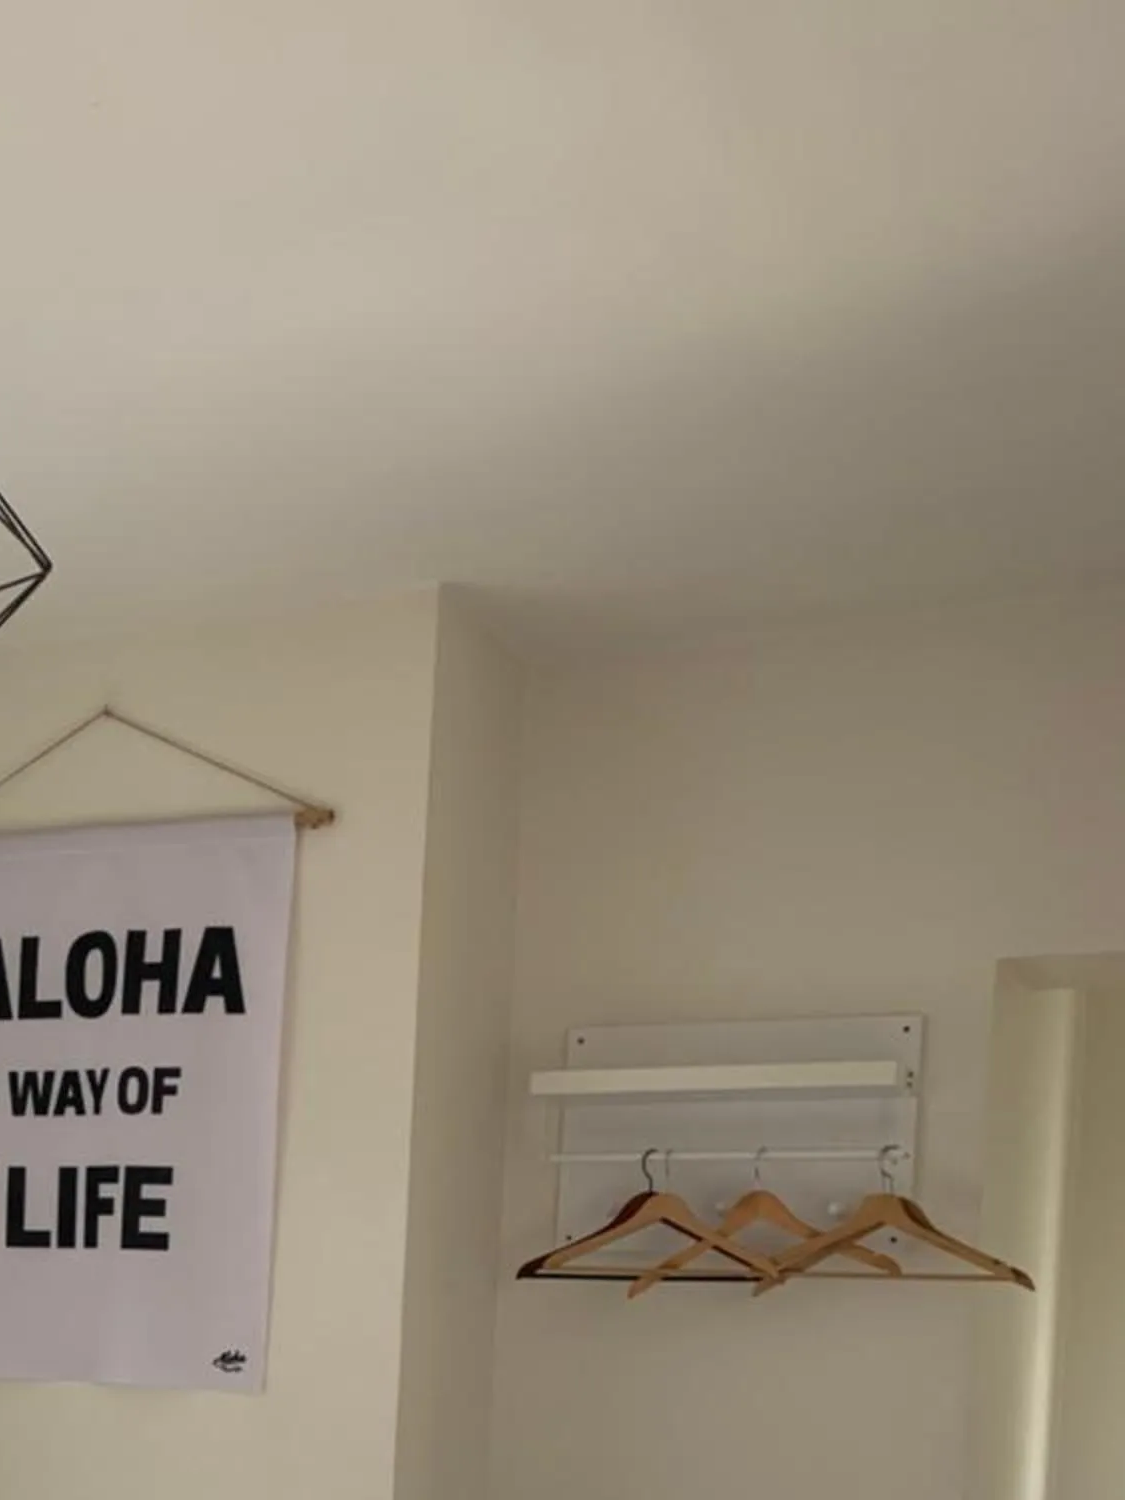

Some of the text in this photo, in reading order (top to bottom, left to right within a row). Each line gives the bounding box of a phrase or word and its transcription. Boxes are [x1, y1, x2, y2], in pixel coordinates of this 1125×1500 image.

[8, 1066, 182, 1116] WAY OF
[5, 1165, 174, 1251] LIFE
